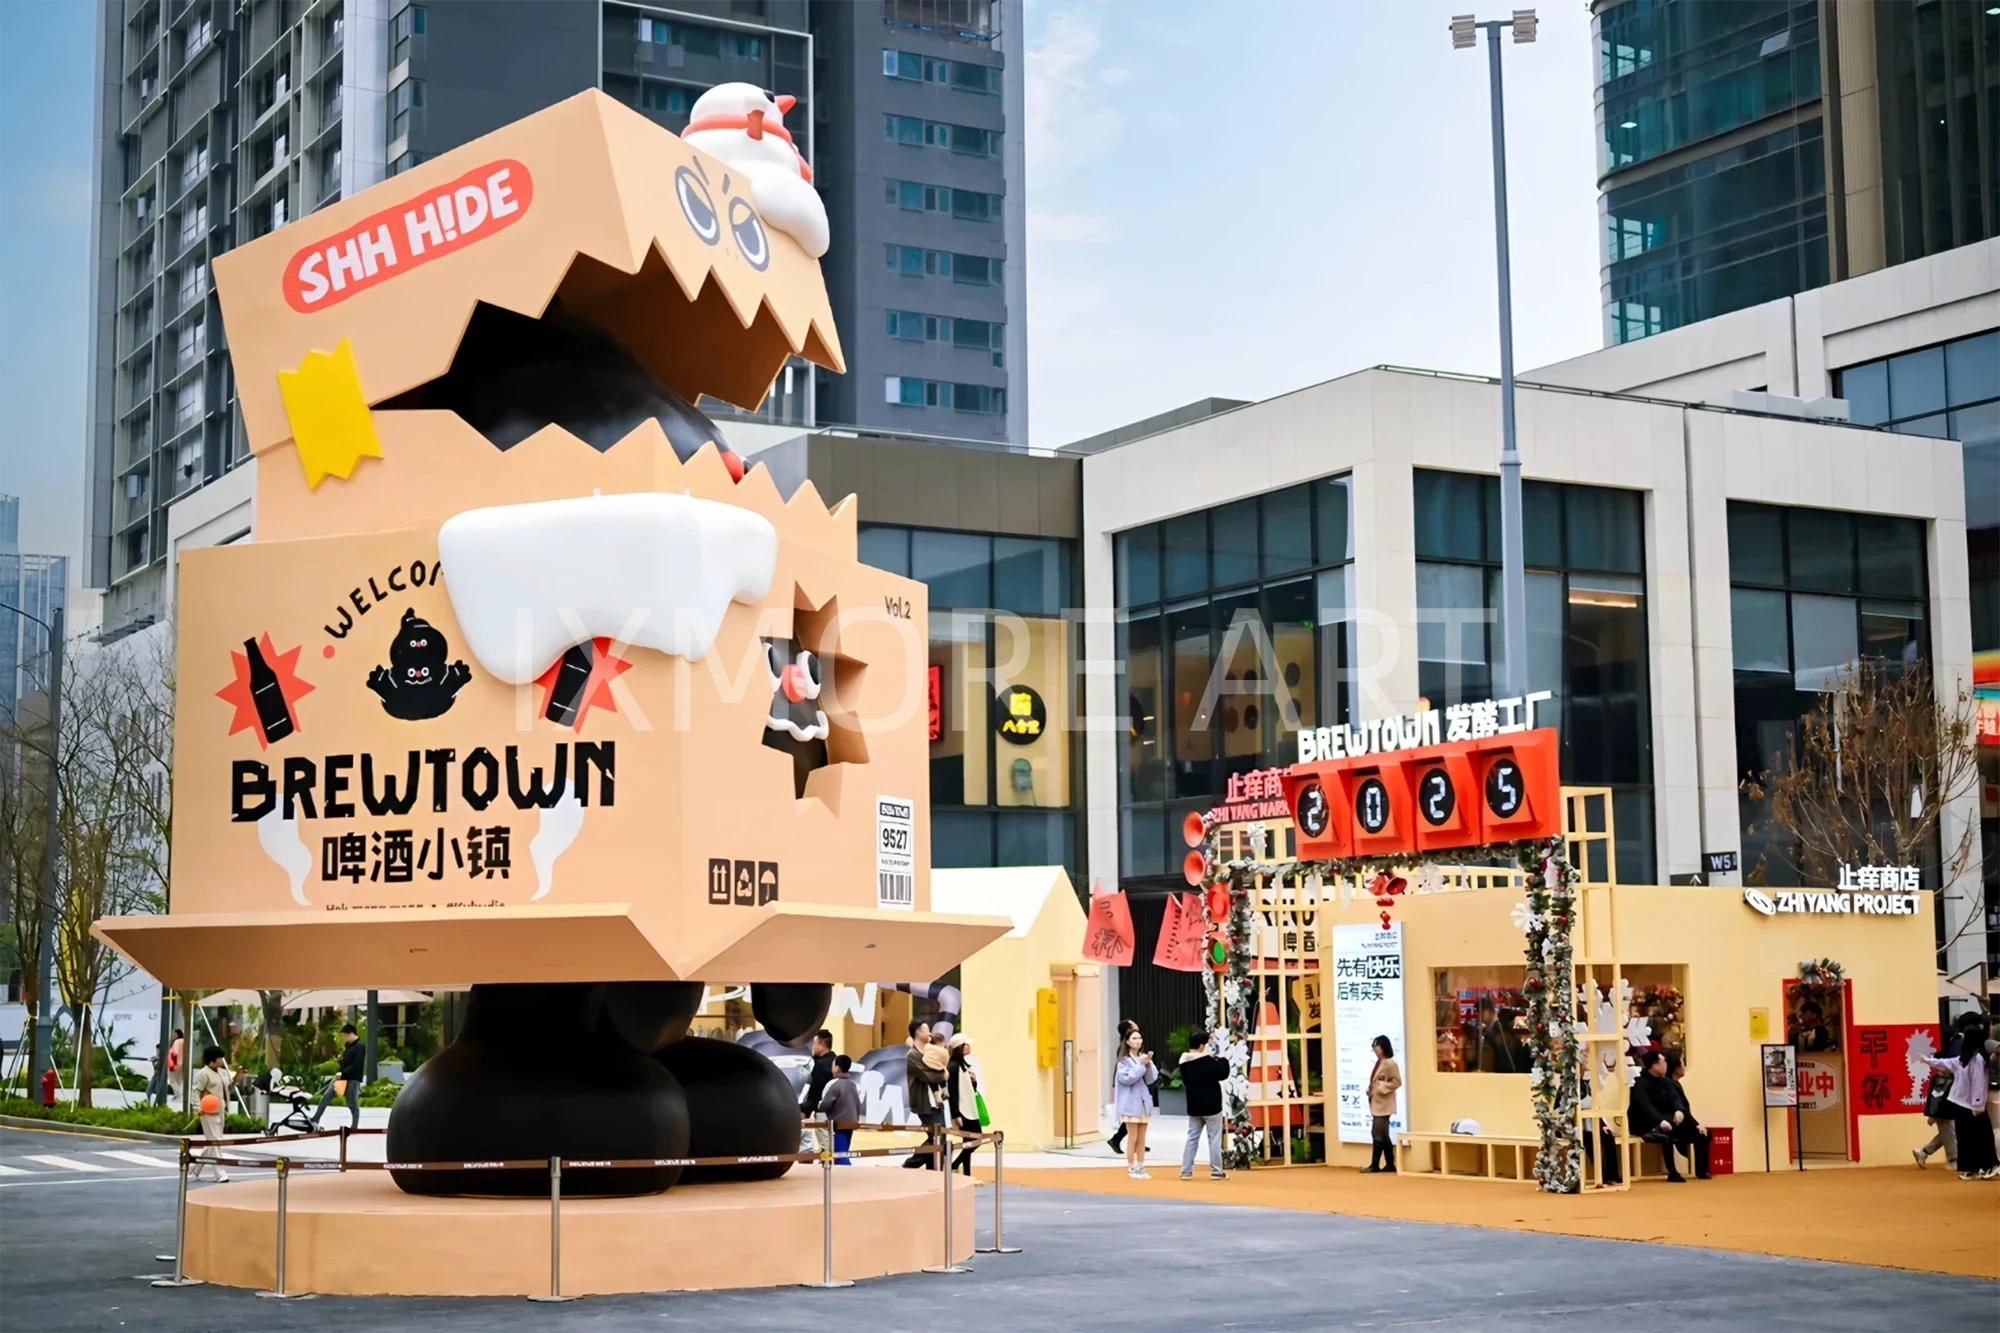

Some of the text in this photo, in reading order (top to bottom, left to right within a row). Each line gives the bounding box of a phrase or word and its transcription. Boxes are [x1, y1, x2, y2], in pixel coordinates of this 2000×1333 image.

[298, 167, 519, 304] SHH H!DE
[1297, 690, 1552, 765] BREWTOWN 发酵工厂
[230, 740, 616, 823] BREWTOWN
[882, 828, 908, 850] 9527
[321, 825, 512, 884] 啤酒小镇
[1710, 854, 1731, 870] W5
[1837, 863, 1920, 892] 止痒商店
[1853, 894, 1921, 915] PROJECT
[1337, 955, 1400, 979] 先有快乐
[1337, 981, 1384, 1001] 后有买卖
